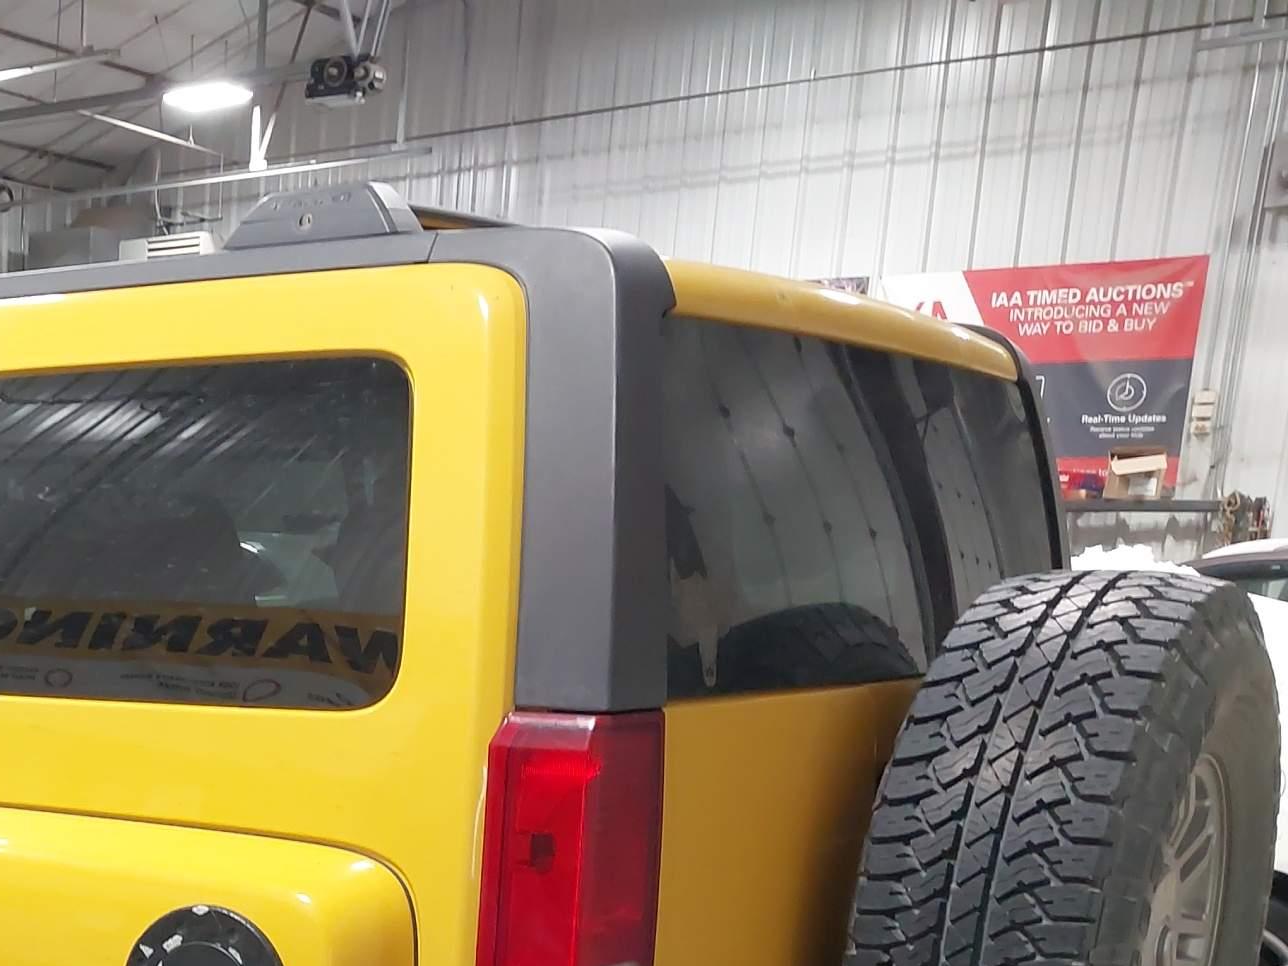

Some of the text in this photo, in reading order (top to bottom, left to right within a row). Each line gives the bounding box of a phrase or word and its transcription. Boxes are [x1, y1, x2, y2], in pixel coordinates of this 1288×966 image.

[991, 291, 1023, 308] IAA
[1026, 287, 1081, 306] TIMED
[1009, 301, 1171, 322] INTRODUCING A NEW
[1018, 317, 1158, 337] WAY TO BID & BUY
[1081, 413, 1167, 425] Real-Time Updates
